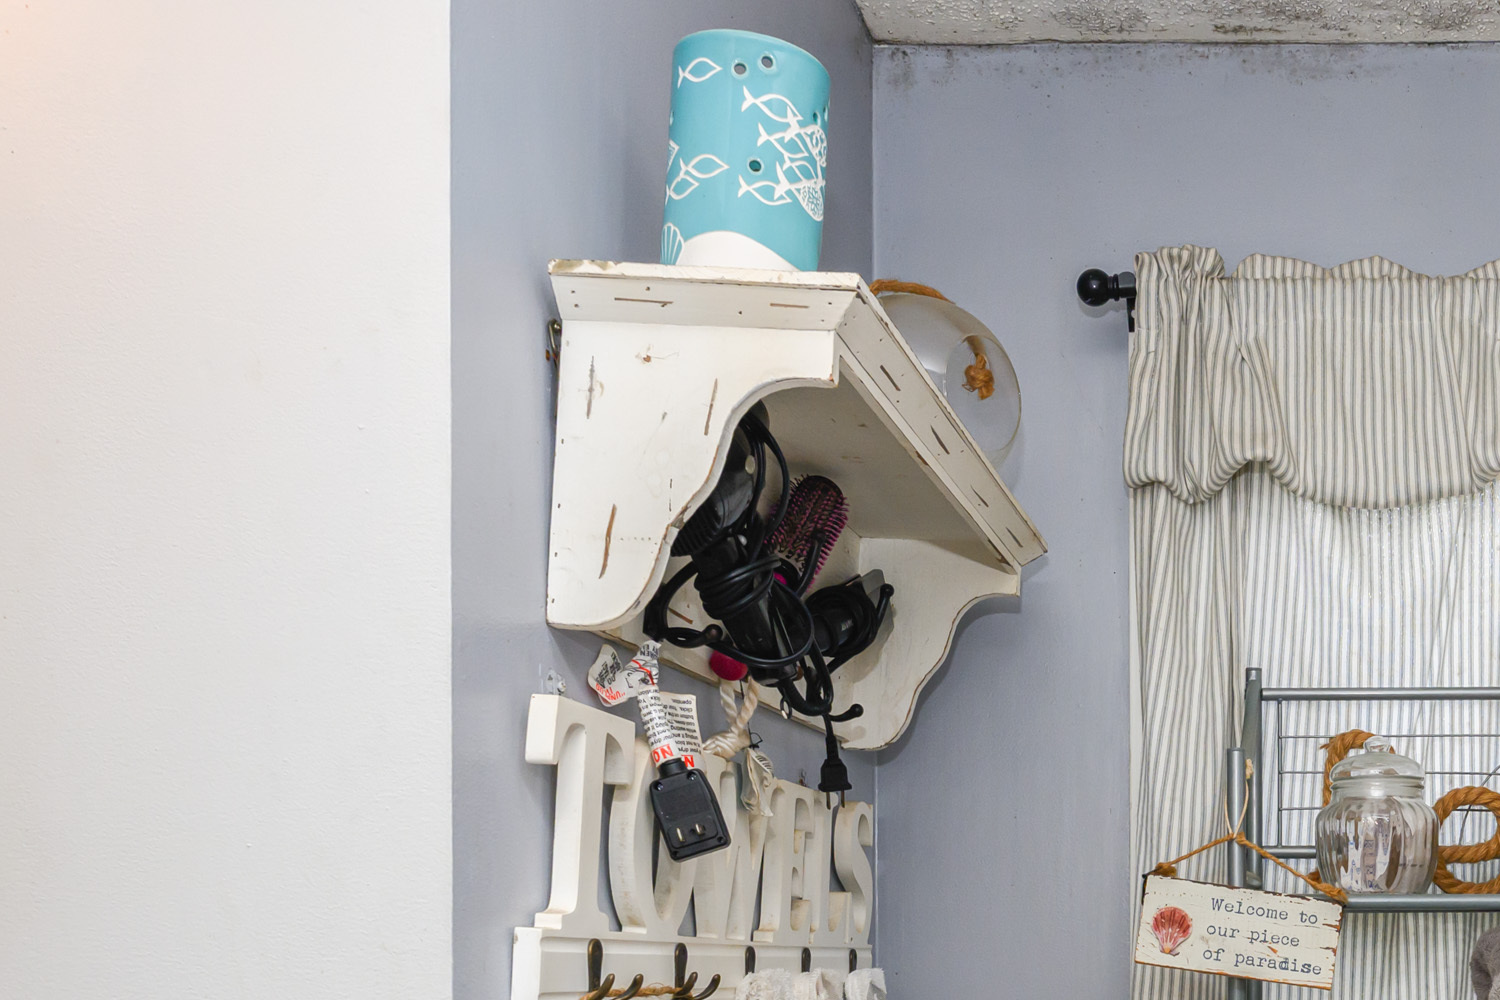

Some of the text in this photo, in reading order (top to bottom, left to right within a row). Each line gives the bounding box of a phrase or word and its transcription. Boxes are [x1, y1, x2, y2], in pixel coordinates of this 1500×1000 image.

[1211, 897, 1318, 925] Welcome to
[1206, 925, 1300, 947] our piece
[1203, 948, 1322, 975] of paradise
